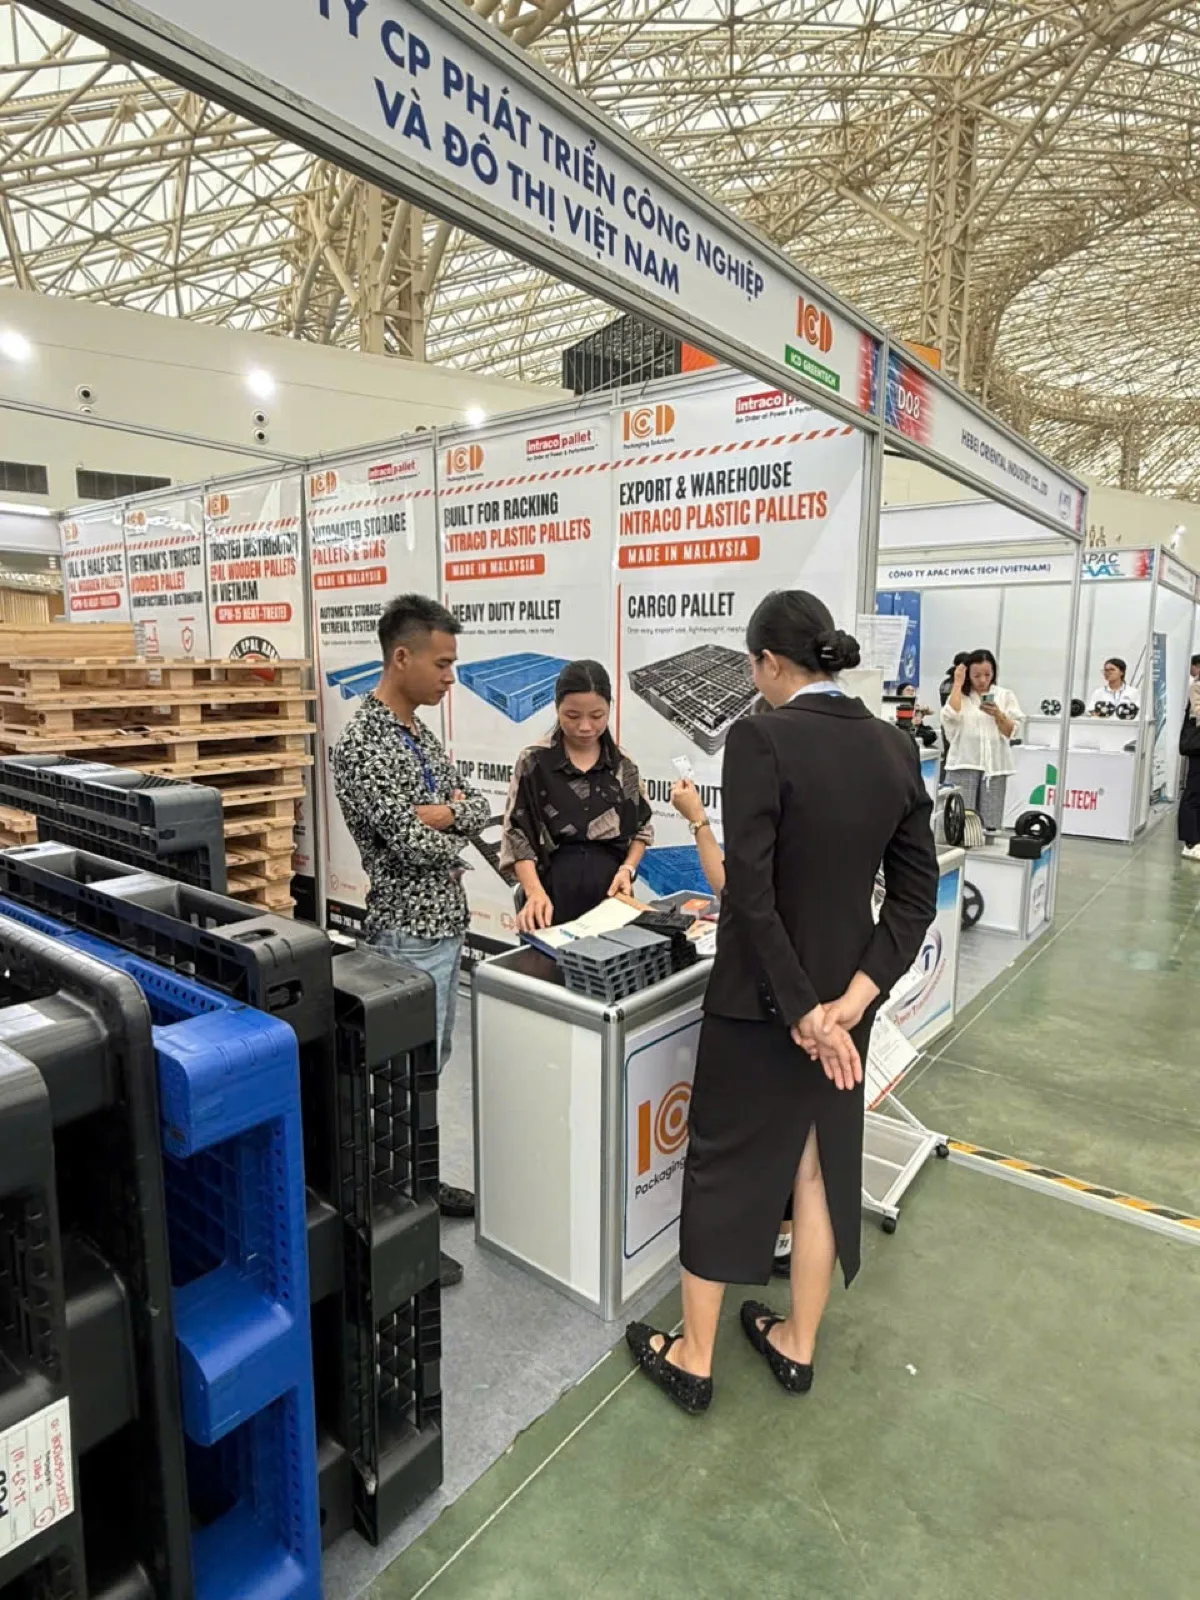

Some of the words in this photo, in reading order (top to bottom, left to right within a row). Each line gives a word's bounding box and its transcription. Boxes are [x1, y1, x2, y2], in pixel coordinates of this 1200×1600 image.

[380, 20, 431, 77] CP
[443, 56, 532, 149] PHÁT
[539, 139, 616, 206] TRIỂN
[623, 185, 691, 252] CÔNG
[696, 233, 765, 302] NGHIỆP
[373, 76, 432, 151] VÀ
[443, 121, 499, 186] ĐÔ
[507, 160, 556, 233] THỊ
[564, 195, 618, 260] VIỆT
[624, 234, 680, 295] NAM
[795, 295, 833, 354] ICD
[737, 394, 782, 412] intraco
[897, 384, 920, 419] D08
[623, 403, 675, 441] ICD
[562, 430, 591, 450] pallet
[446, 444, 485, 476] ICD
[619, 477, 672, 506] EXPORT
[675, 475, 687, 500] &
[690, 461, 793, 499] WAREHOUSE
[444, 504, 474, 528] BUILT
[478, 500, 500, 524] FOR
[503, 492, 559, 521] RACKING
[619, 506, 682, 536] INTRACO
[685, 499, 751, 530] PLASTIC
[755, 490, 828, 525] PALLETS
[364, 513, 407, 538] STORAGE
[490, 524, 536, 549] PLASTIC
[540, 517, 591, 544] PALLETS
[168, 545, 201, 569] TRUSTED
[627, 545, 661, 565] MADE
[664, 544, 678, 562] IN
[683, 541, 749, 561] MALAYSIA
[228, 559, 261, 581] WOODEN
[264, 556, 297, 579] PALLETS
[451, 561, 475, 577] MADE
[478, 560, 487, 576] IN
[489, 558, 536, 575] MALAYSIA
[927, 567, 950, 577] APAC
[220, 580, 259, 602] VIETNAM
[320, 605, 353, 620] AUTOMATIC
[452, 602, 485, 624] HEAVY
[488, 601, 516, 622] DUTY
[519, 599, 562, 621] PALLET
[628, 593, 677, 619] CARGO
[680, 591, 735, 618] PALLET
[320, 620, 351, 635] RETRIEVAL
[352, 619, 377, 633] SYSTEM
[455, 760, 475, 778] TOP
[477, 761, 513, 783] FRAME
[637, 1081, 693, 1176] IC
